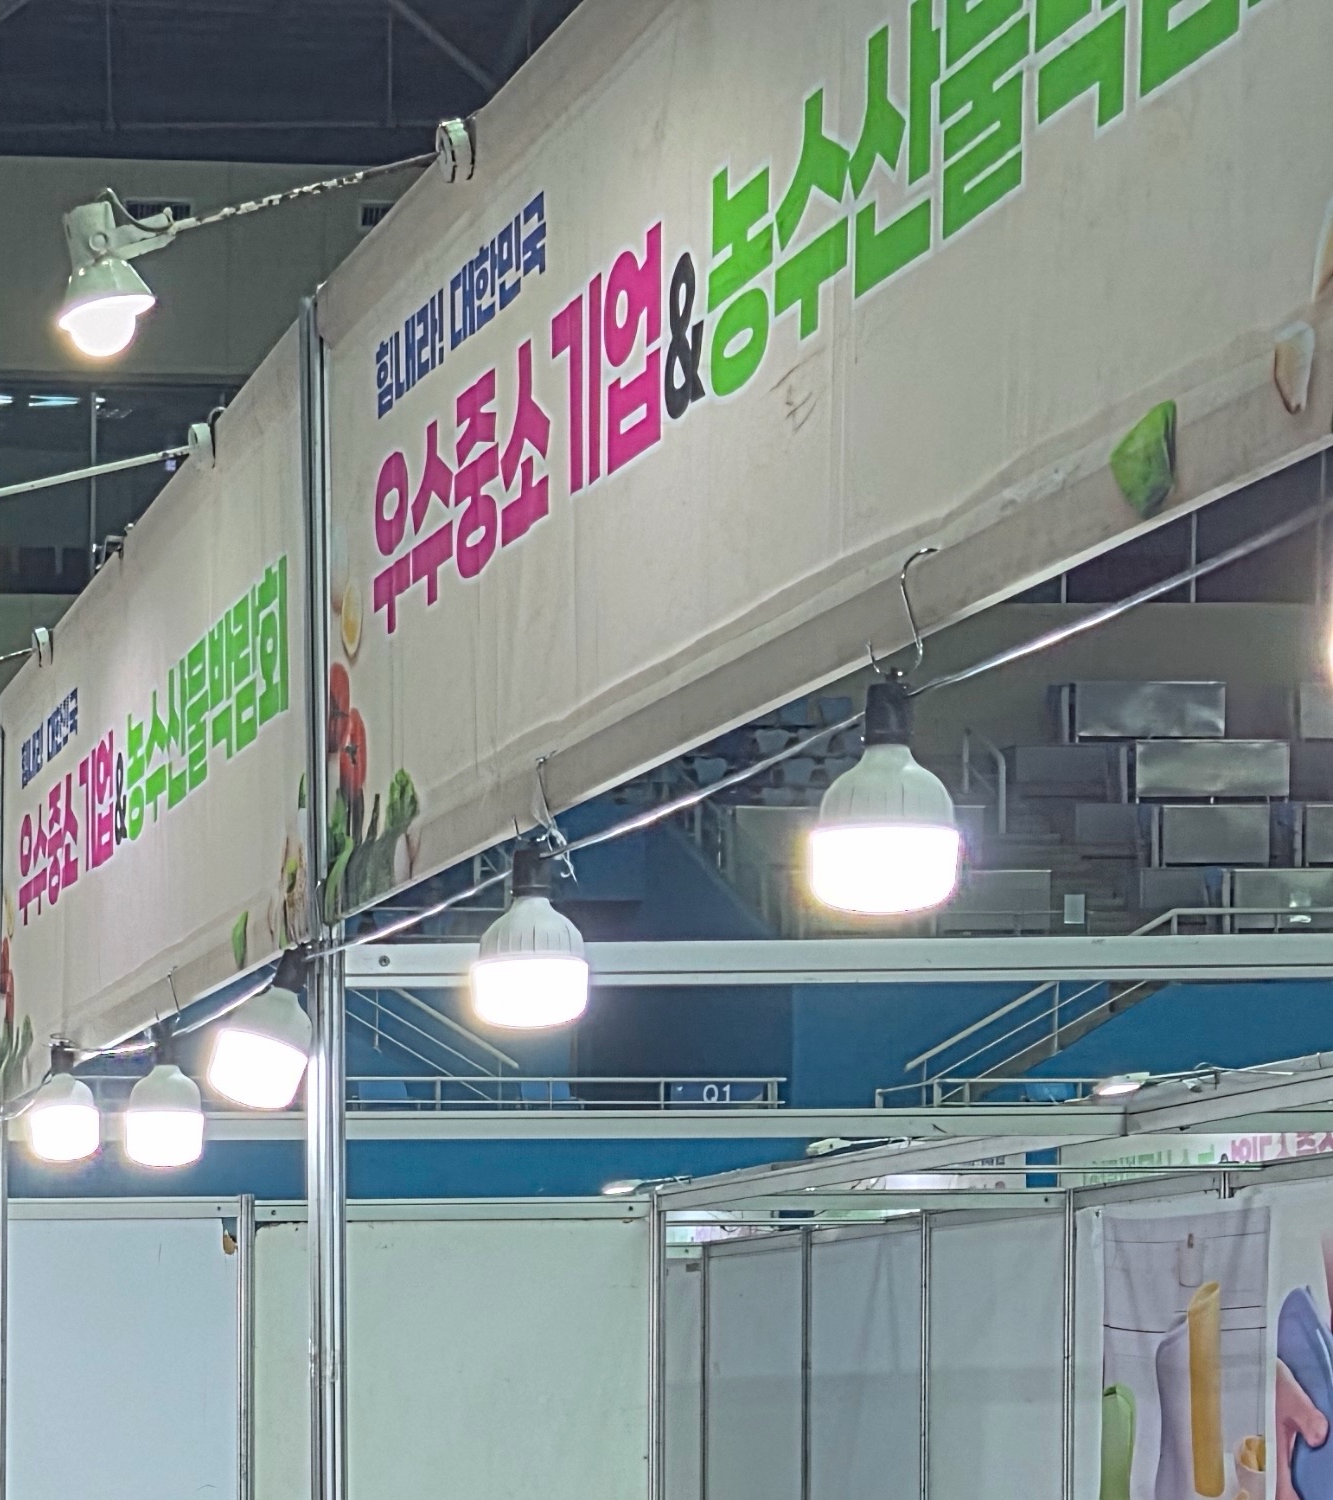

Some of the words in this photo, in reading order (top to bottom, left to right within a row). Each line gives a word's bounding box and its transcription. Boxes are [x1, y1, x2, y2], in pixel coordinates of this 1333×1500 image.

[376, 309, 444, 419] 힘내라!
[449, 193, 547, 352] 대한민국
[18, 554, 290, 926] 우수중소기업&농수산물박람회
[702, 1083, 731, 1103] Q1
